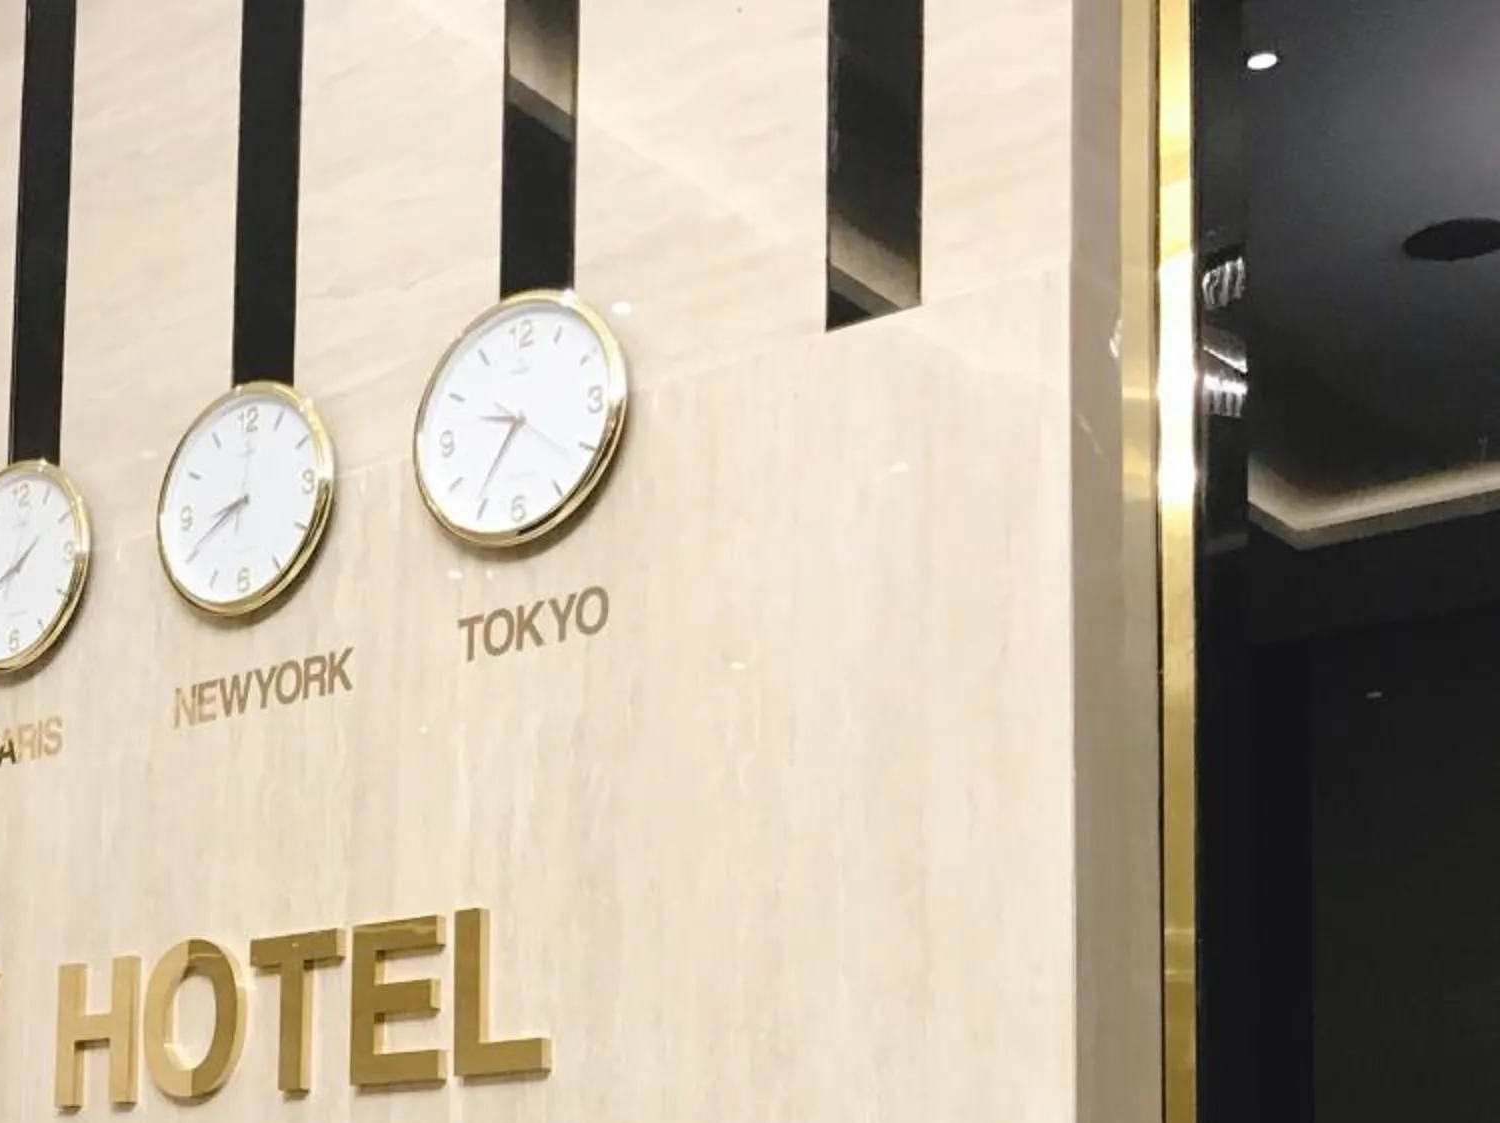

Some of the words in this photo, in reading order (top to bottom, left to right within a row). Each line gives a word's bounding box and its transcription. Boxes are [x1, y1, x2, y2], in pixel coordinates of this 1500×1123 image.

[509, 319, 534, 348] 12
[588, 386, 604, 414] 3
[440, 430, 455, 458] 9
[511, 496, 526, 523] 6
[236, 568, 251, 592] 6
[457, 586, 610, 661] TOKYO
[173, 646, 354, 729] NEWYORK
[54, 907, 552, 1112] HOTEL
